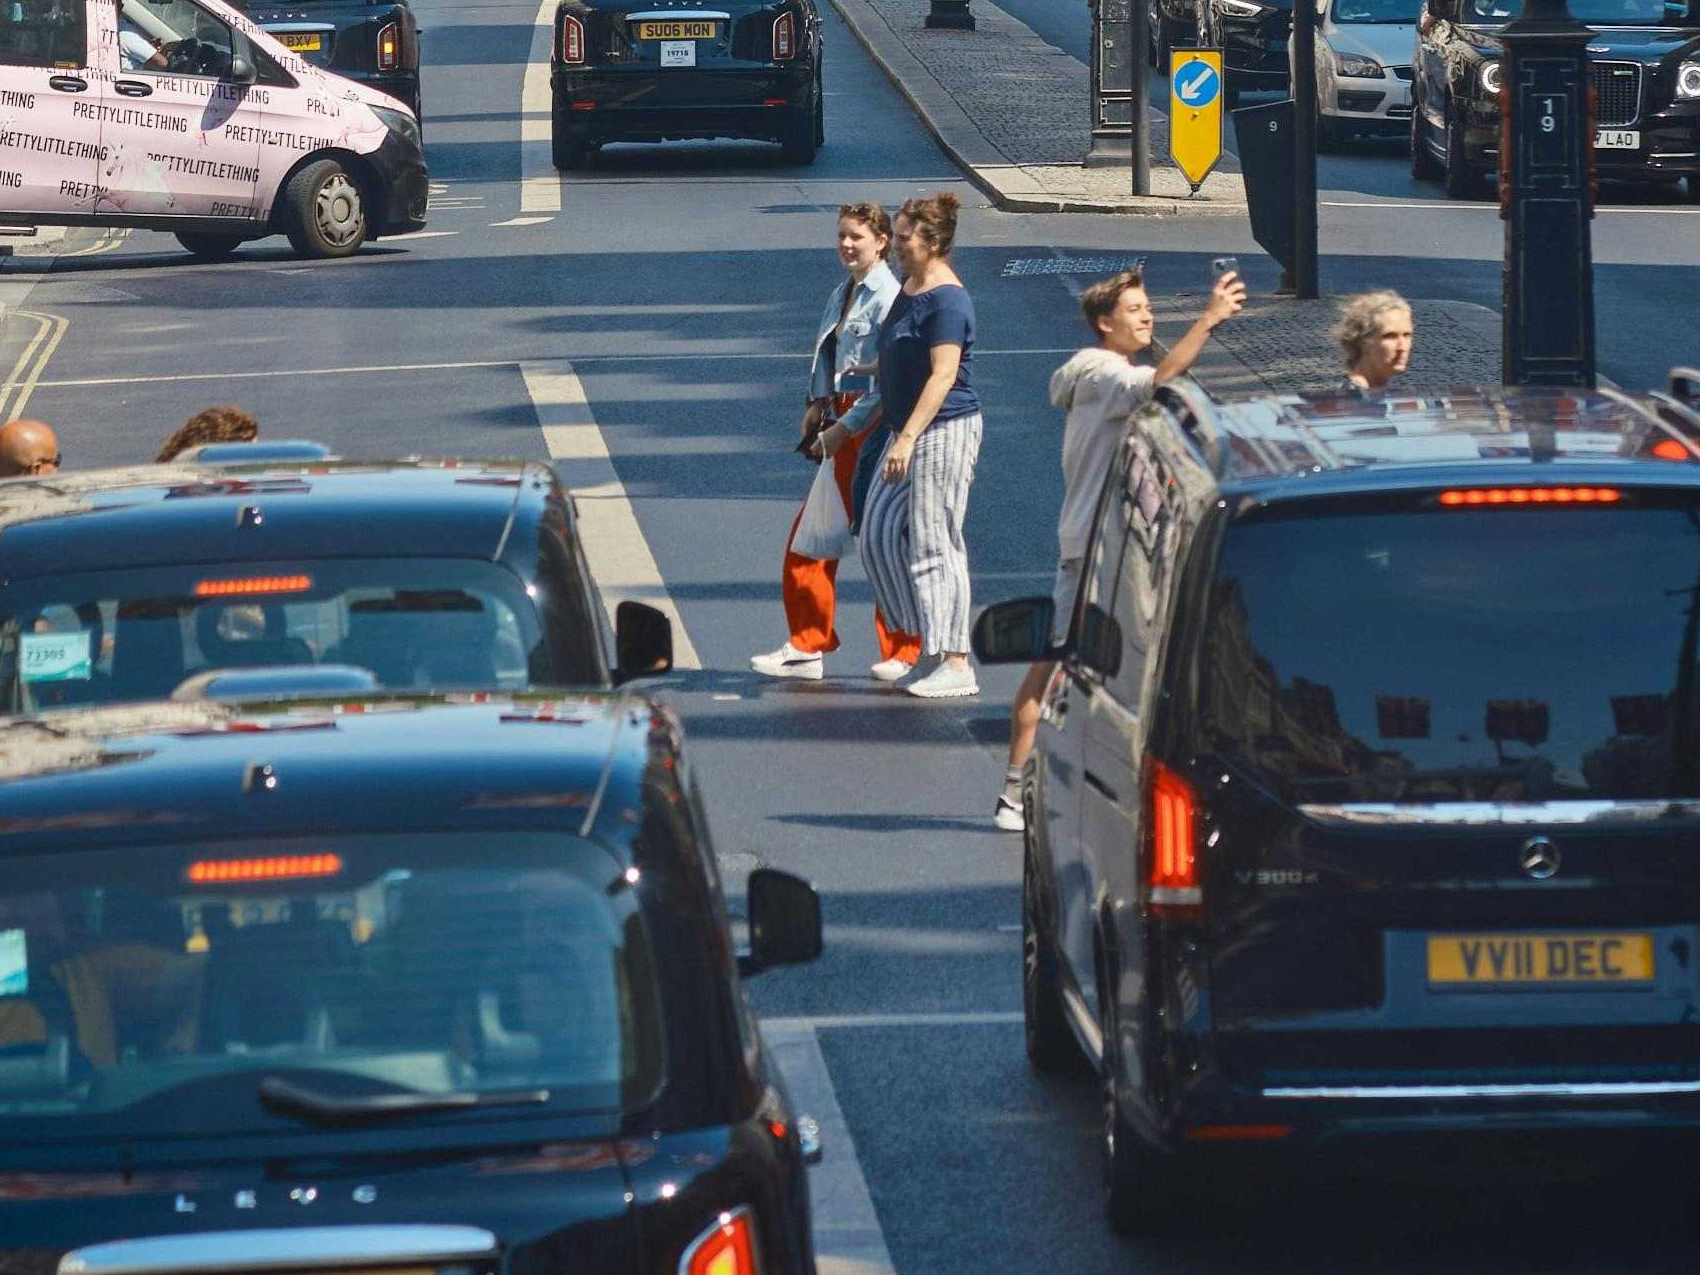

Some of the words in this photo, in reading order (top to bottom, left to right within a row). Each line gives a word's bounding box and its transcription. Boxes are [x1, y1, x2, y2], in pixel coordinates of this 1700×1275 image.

[646, 24, 680, 37] SU06
[156, 77, 270, 105] PRETTYLITTLETHING
[73, 101, 188, 133] PRETTYLITTLETHING
[1269, 121, 1277, 131] 9
[225, 124, 333, 151] PRETTYLITTLETHIN
[1546, 940, 1623, 976] DEC
